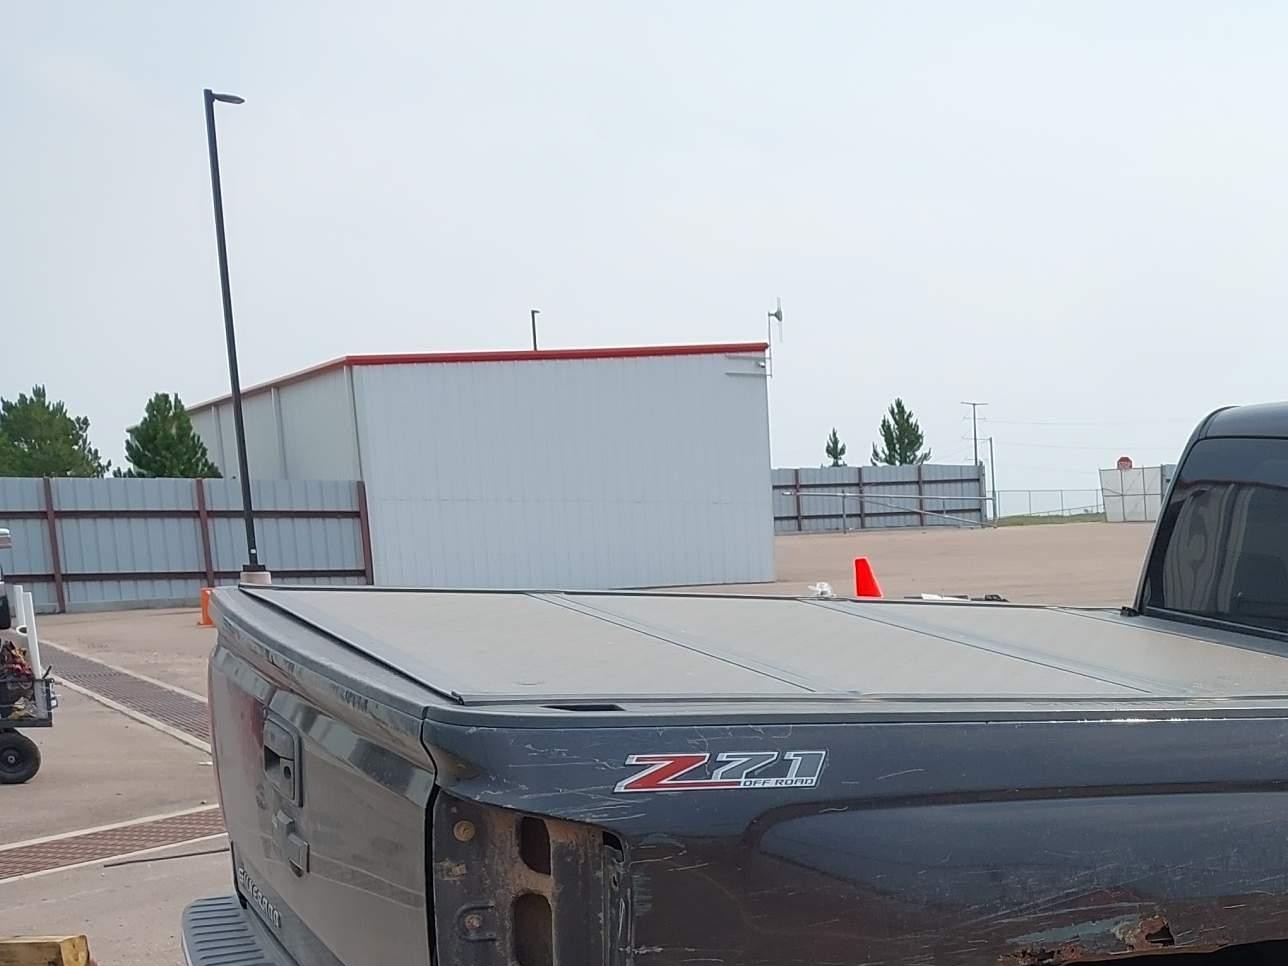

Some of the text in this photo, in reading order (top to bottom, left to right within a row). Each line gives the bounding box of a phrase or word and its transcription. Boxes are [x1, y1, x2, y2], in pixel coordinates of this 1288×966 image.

[613, 751, 827, 793] Z71
[743, 778, 815, 787] OFF ROAD
